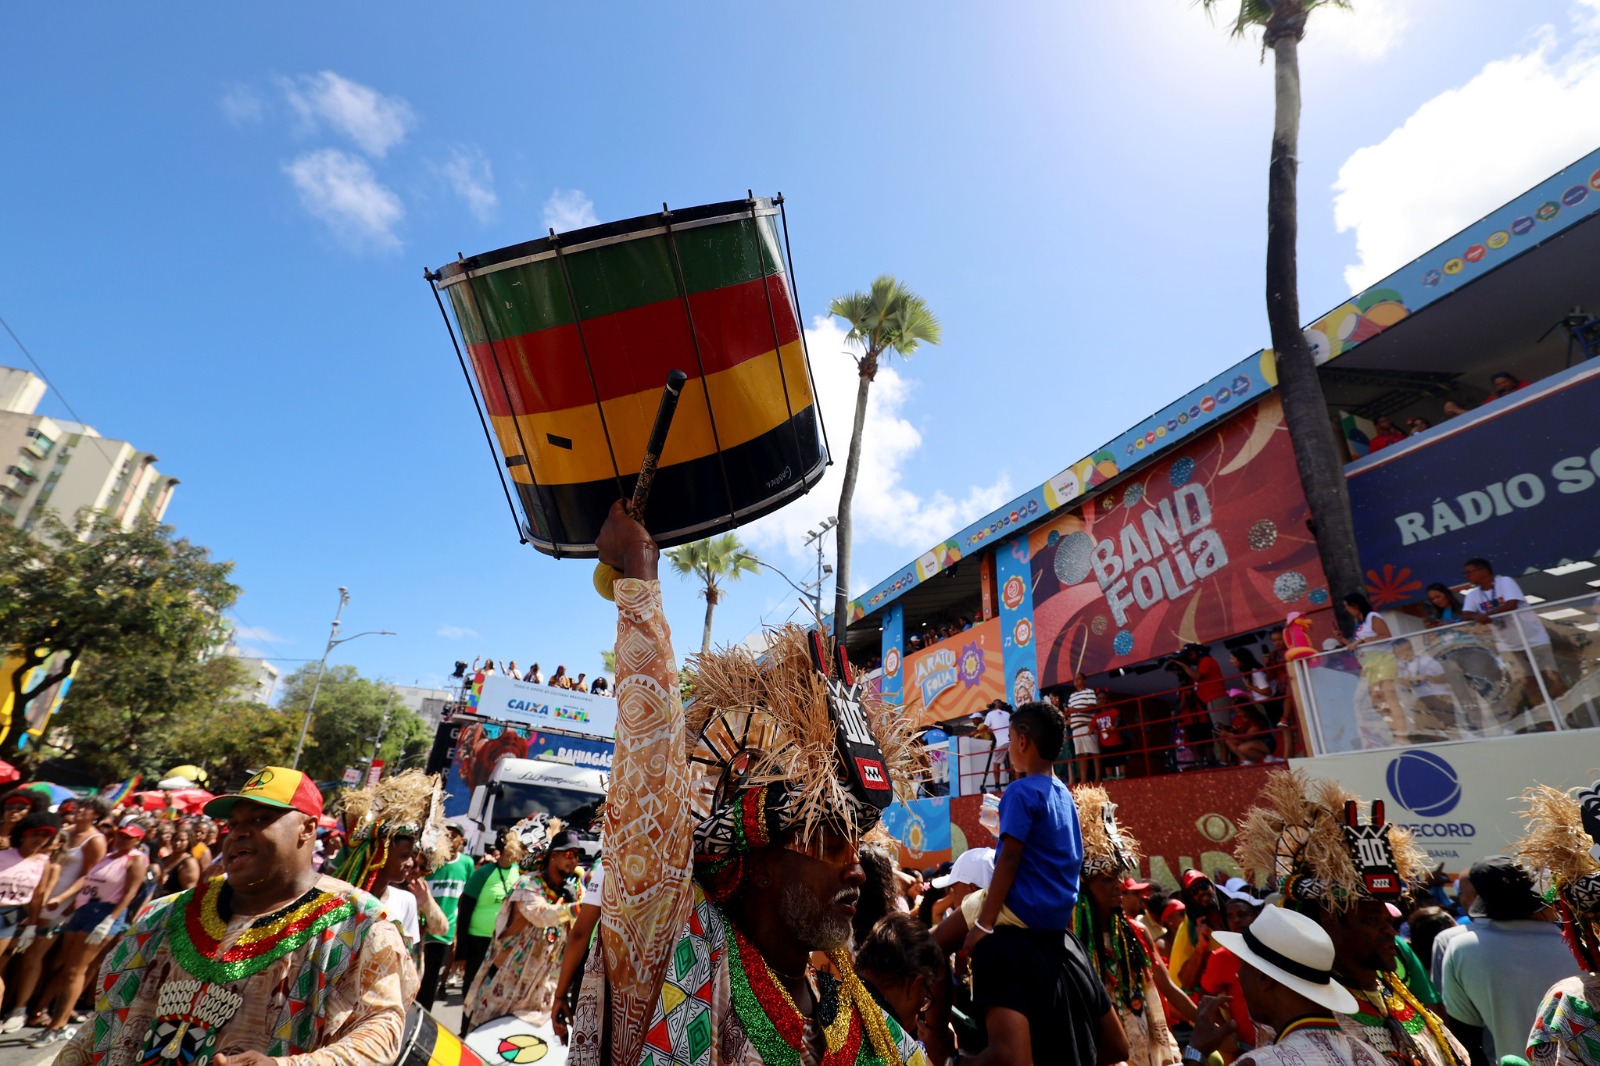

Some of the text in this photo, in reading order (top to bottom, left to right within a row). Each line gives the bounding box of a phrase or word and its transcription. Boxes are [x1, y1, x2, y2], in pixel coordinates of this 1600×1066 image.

[1395, 446, 1600, 546] RÁDIO S
[1090, 482, 1212, 590] BAND
[915, 649, 955, 686] ARATU
[926, 670, 953, 697] FOLIA
[507, 699, 549, 715] CAIXA
[1427, 849, 1460, 858] BAHIA
